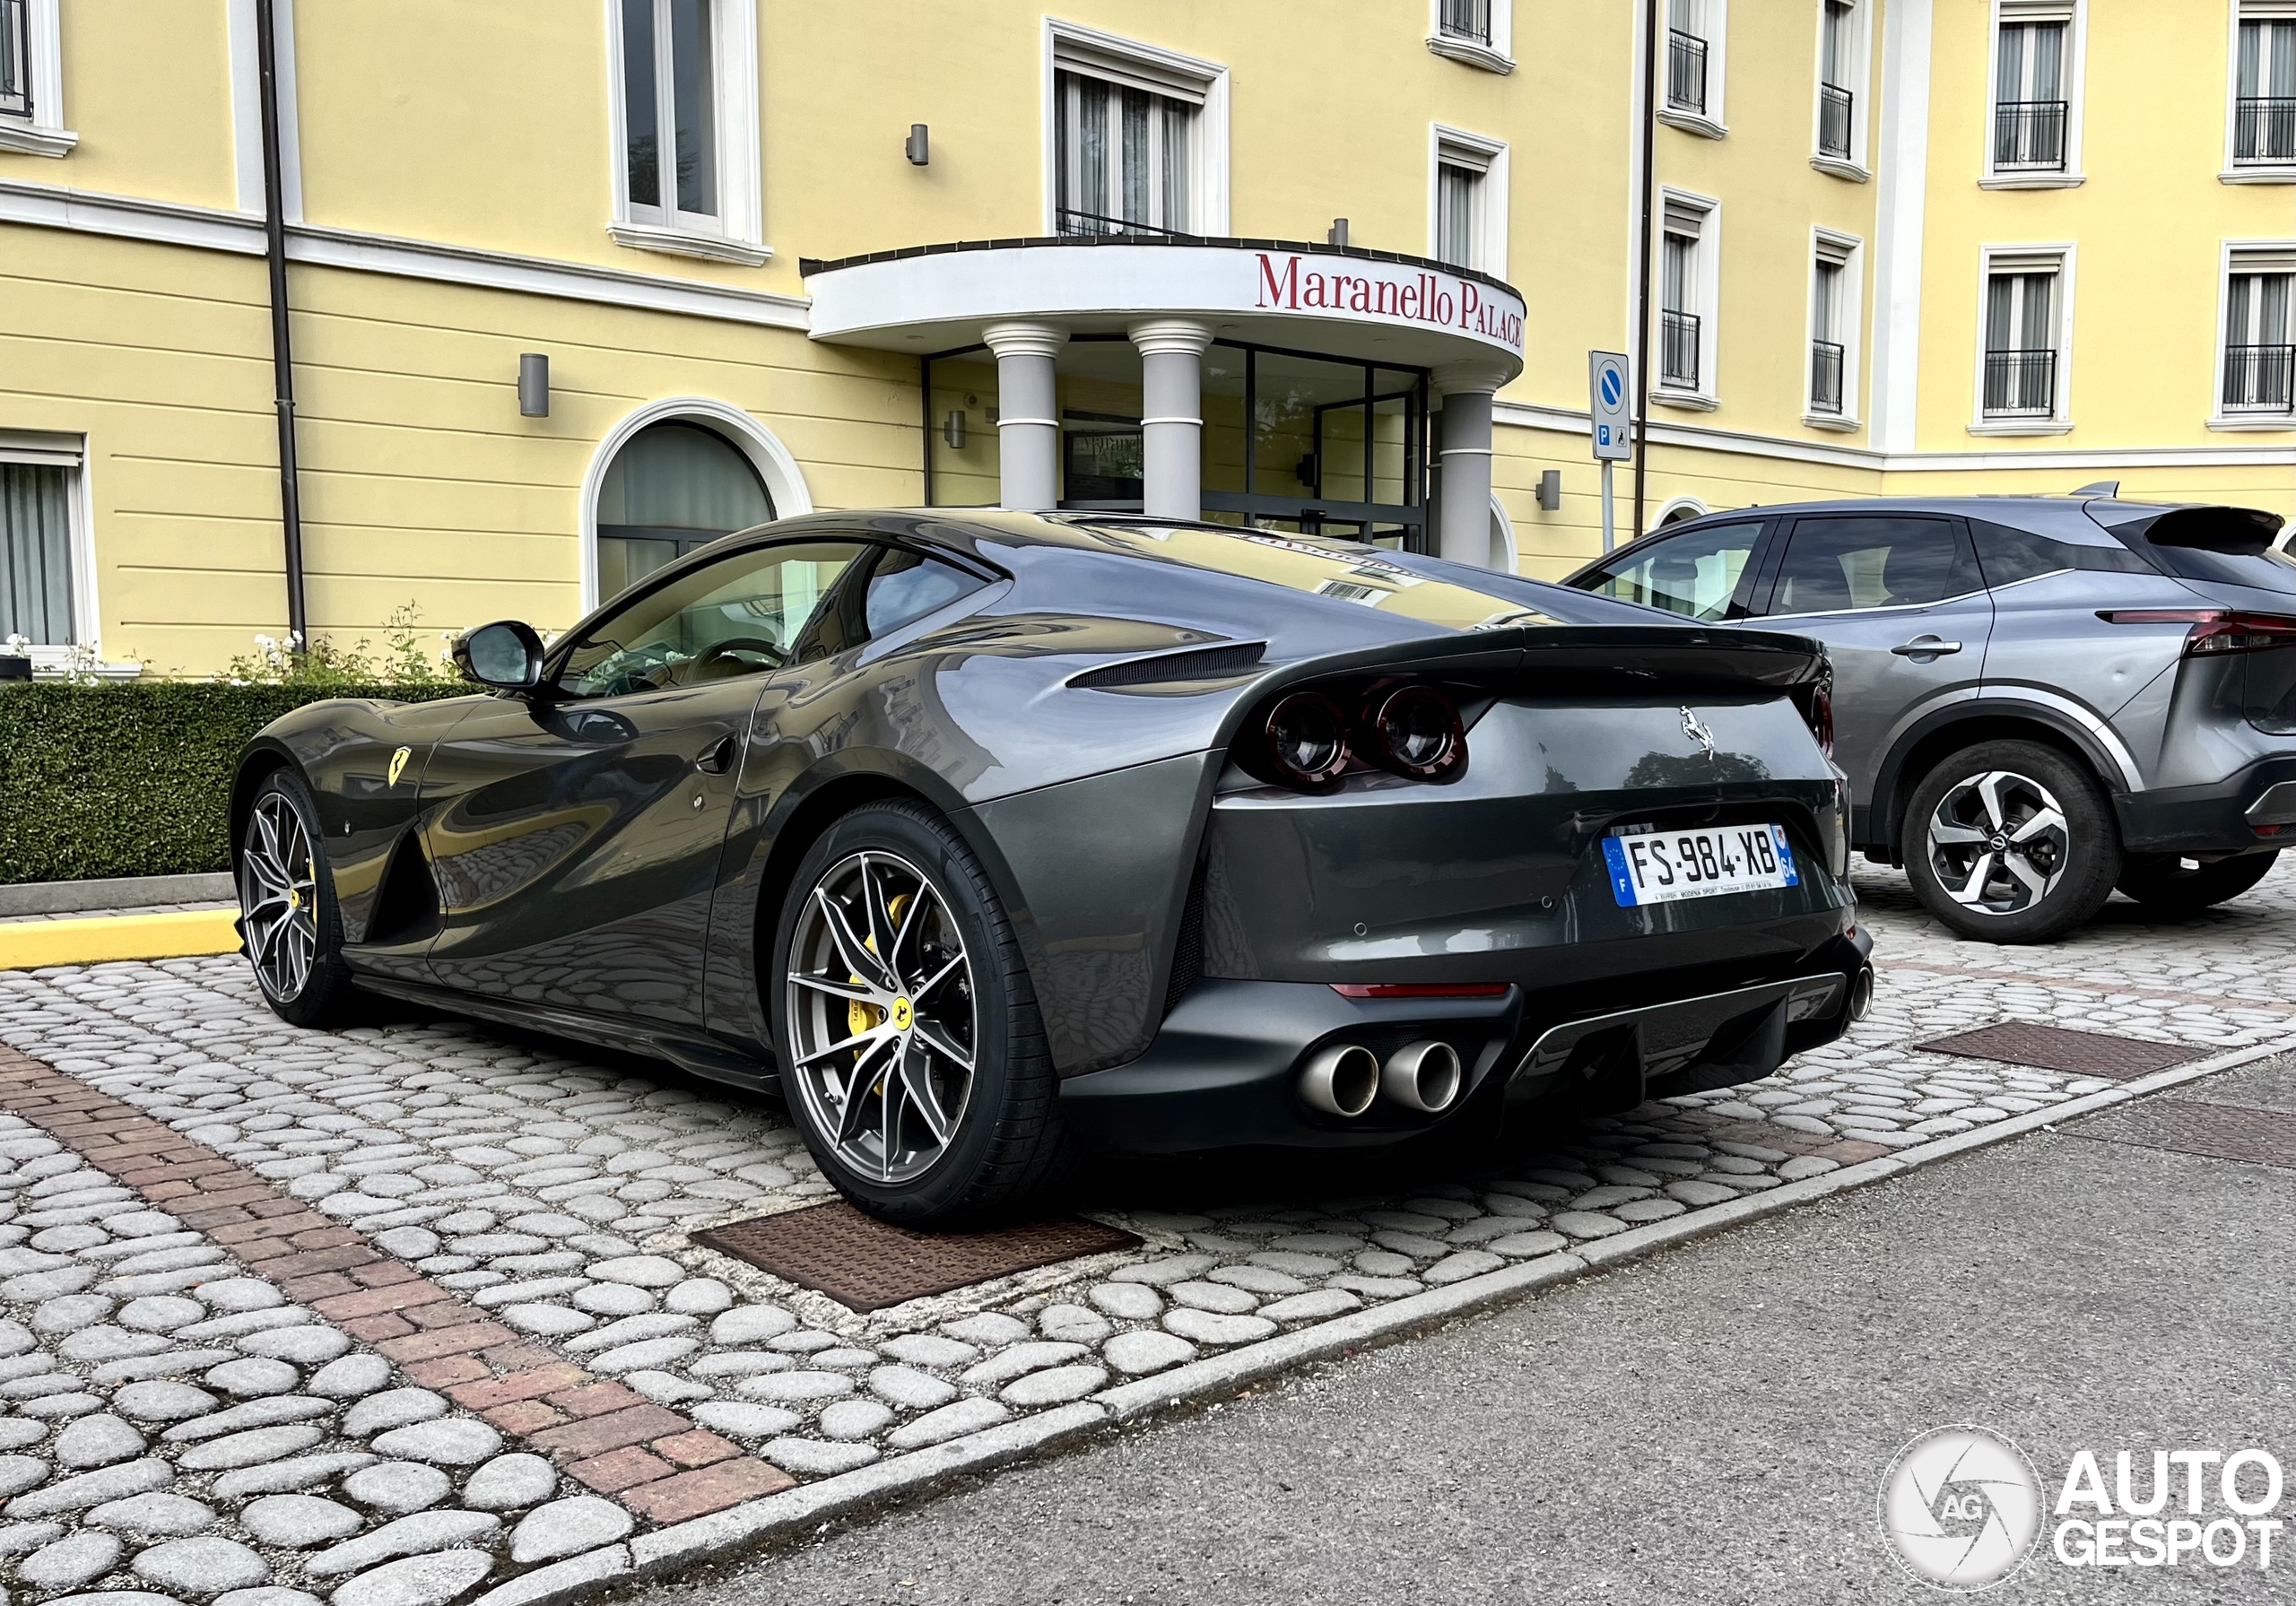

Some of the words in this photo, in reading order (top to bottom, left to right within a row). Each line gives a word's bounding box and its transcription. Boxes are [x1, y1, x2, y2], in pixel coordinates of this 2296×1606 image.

[1255, 253, 1454, 326] Maranello
[1458, 281, 1522, 349] PALACE
[1600, 427, 1608, 443] P
[1779, 855, 1797, 879] 64
[1618, 878, 1626, 893] F
